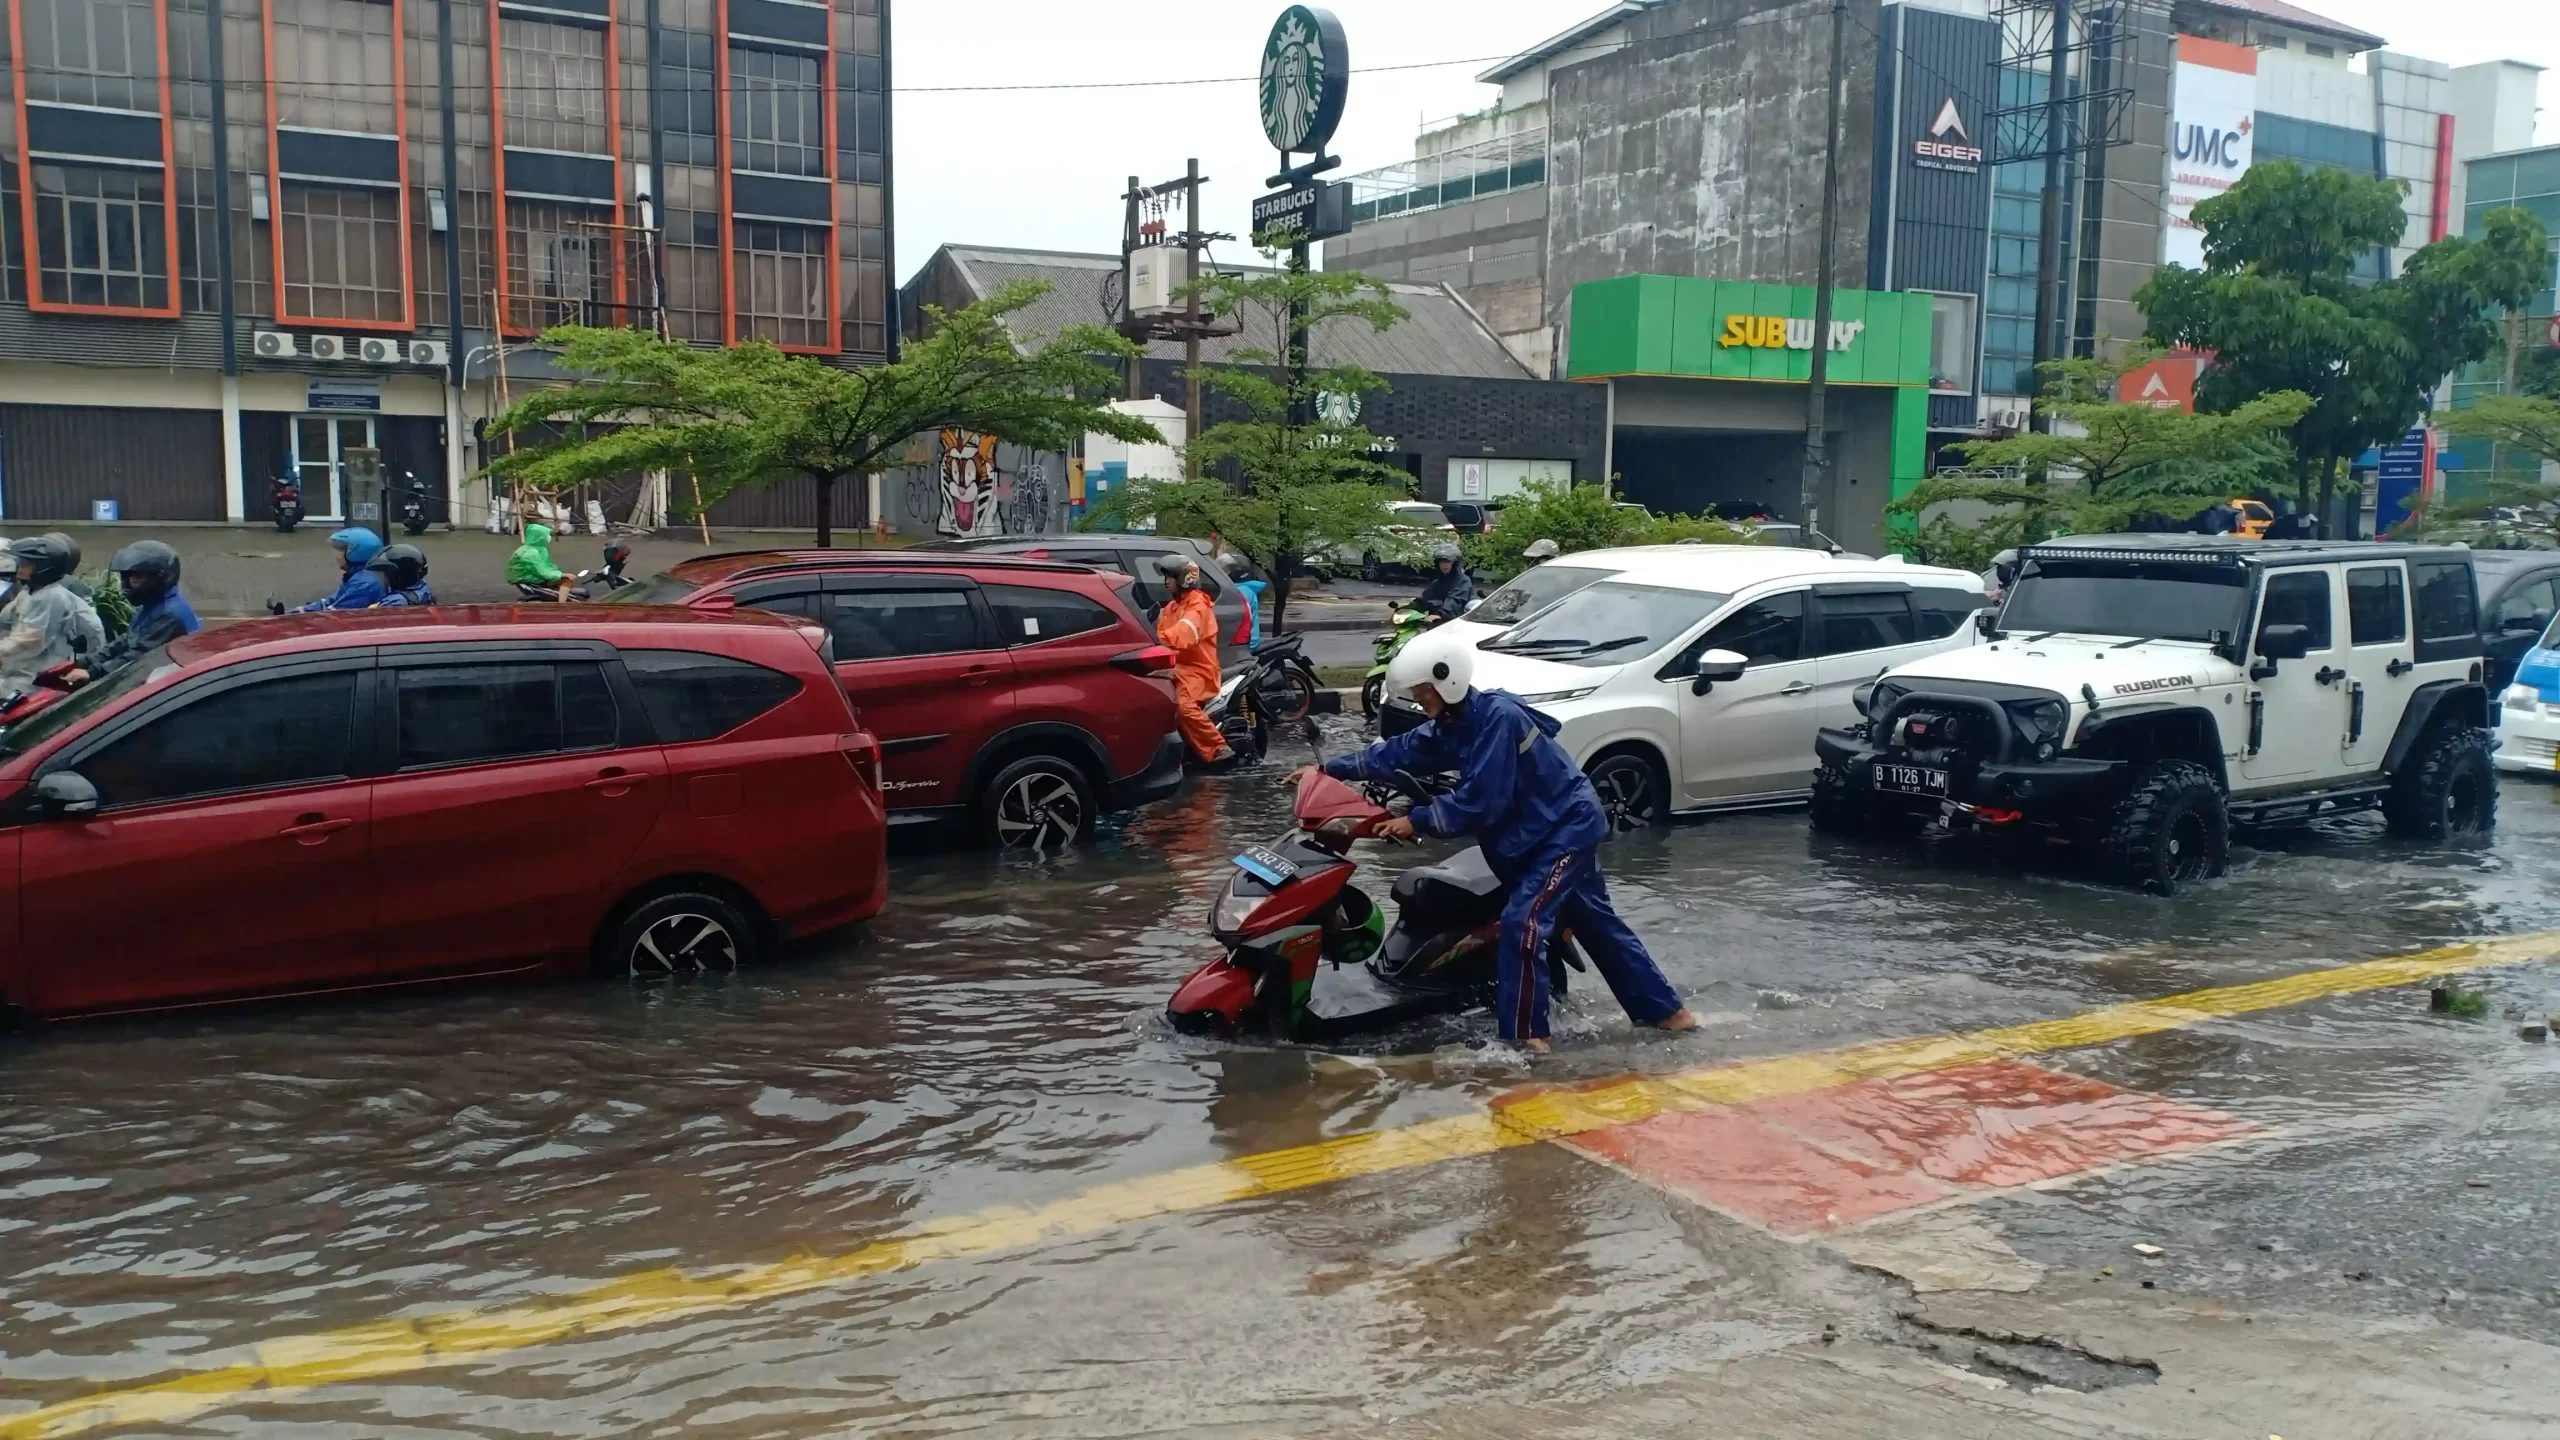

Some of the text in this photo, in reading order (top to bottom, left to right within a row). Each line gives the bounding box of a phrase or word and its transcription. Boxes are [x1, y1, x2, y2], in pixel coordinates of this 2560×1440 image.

[1915, 141, 1982, 162] EIGER
[1917, 160, 1942, 169] TROPICAL
[1254, 188, 1315, 220] STARBUCKS
[2113, 675, 2194, 694] RUBICON
[1875, 766, 1944, 788] B 1126 TJM
